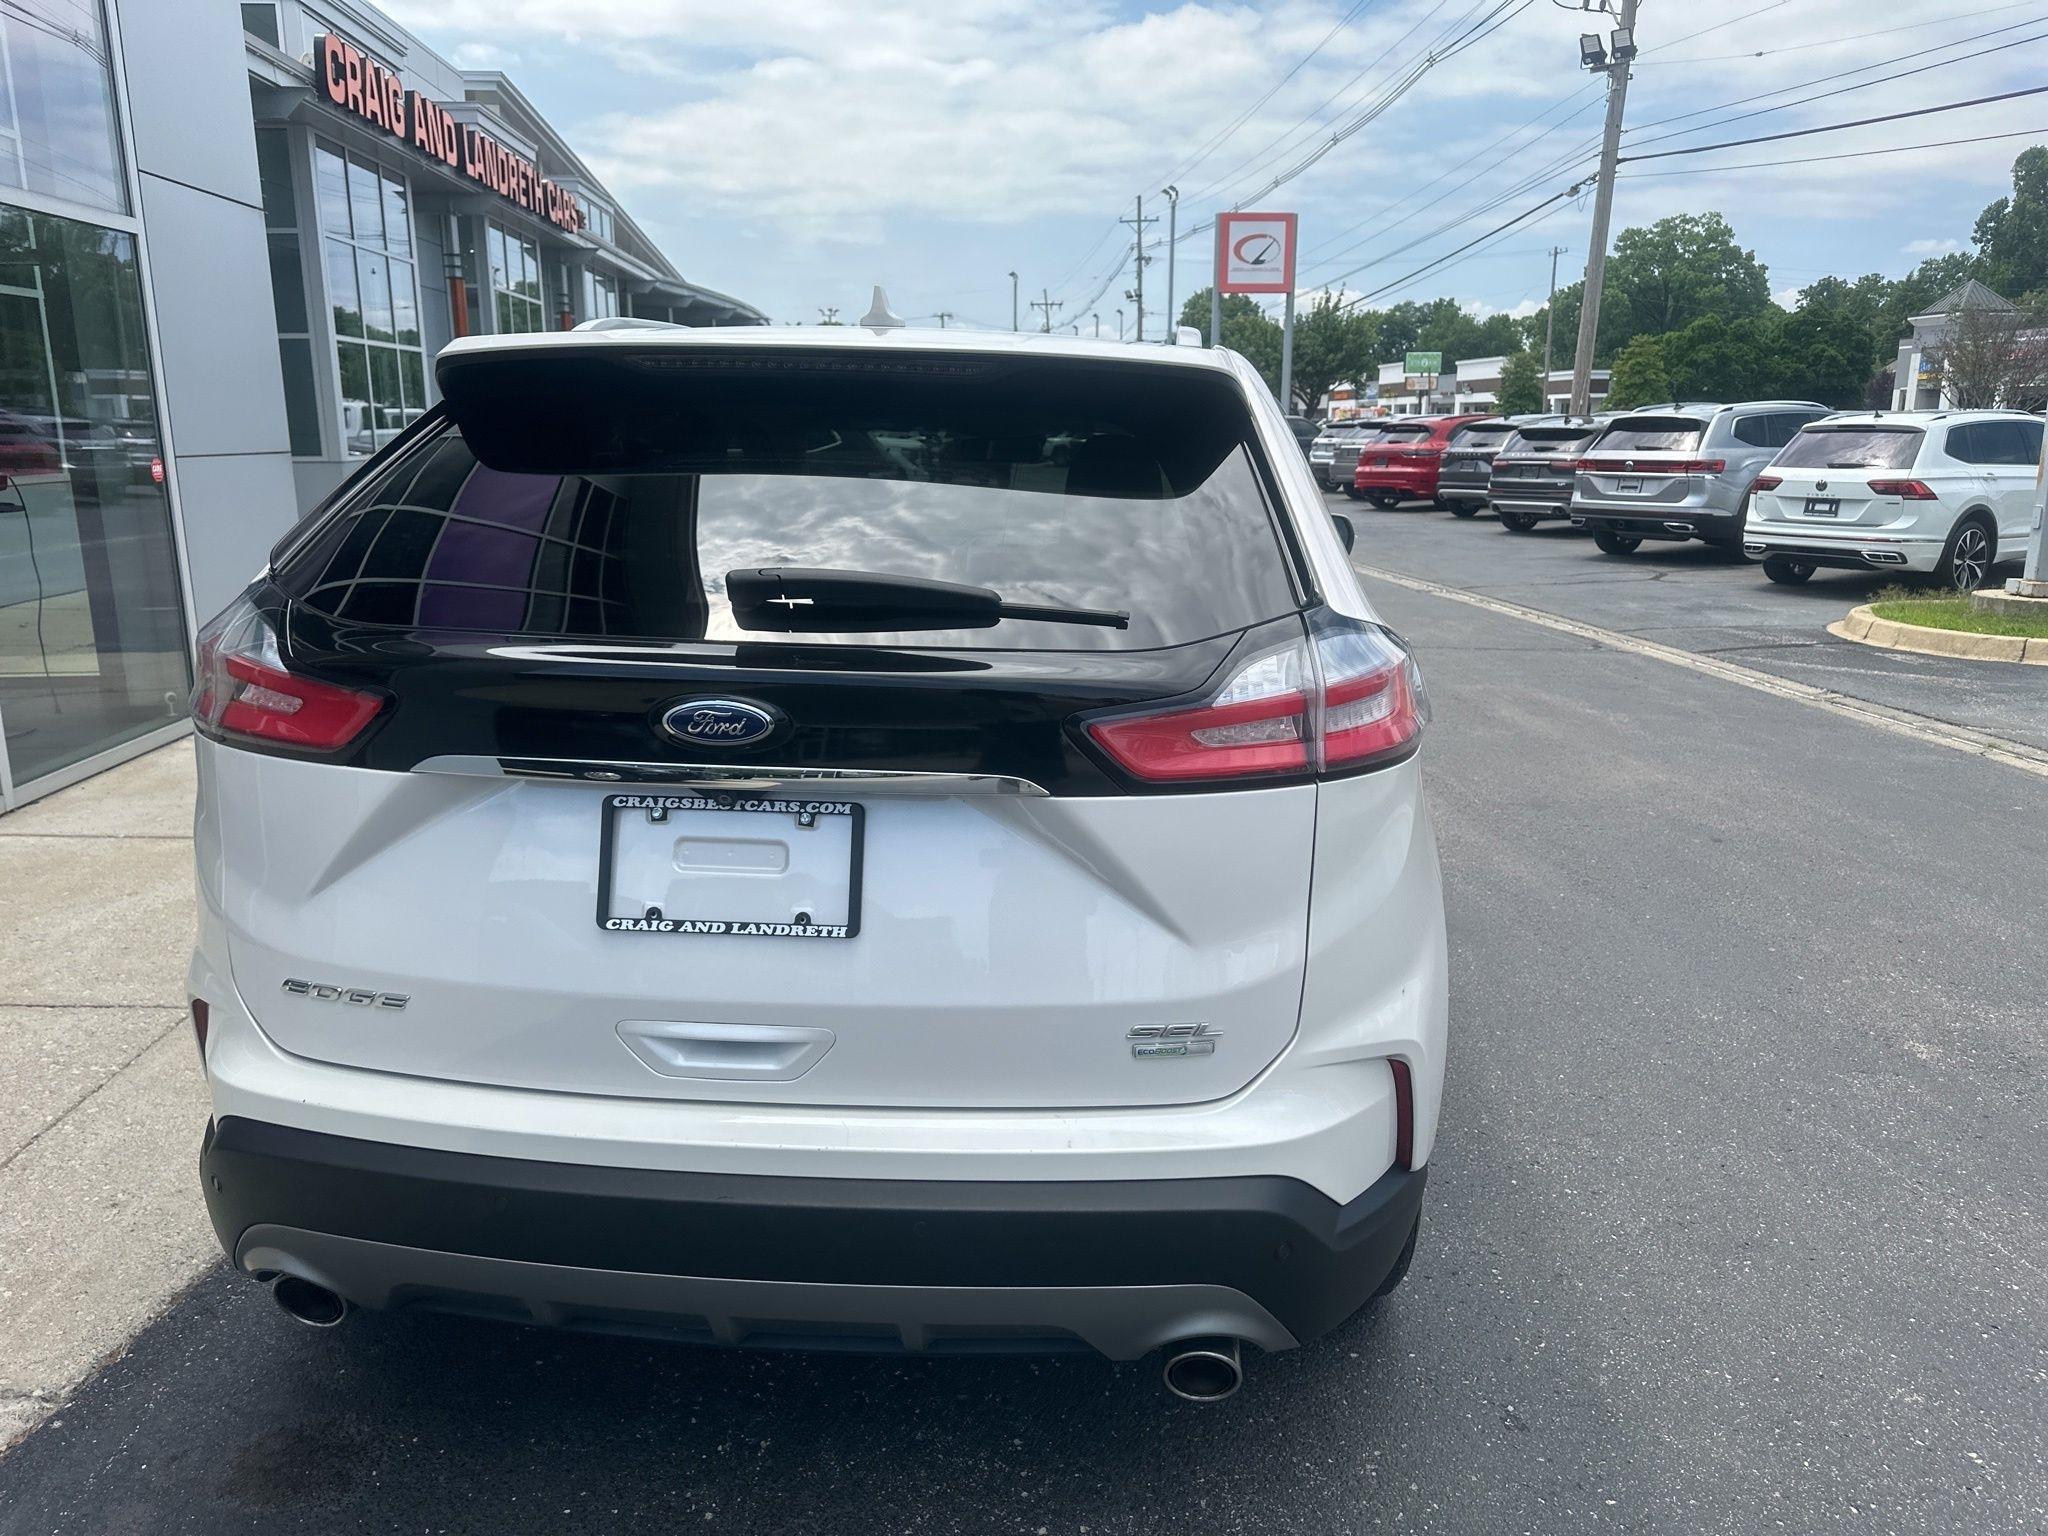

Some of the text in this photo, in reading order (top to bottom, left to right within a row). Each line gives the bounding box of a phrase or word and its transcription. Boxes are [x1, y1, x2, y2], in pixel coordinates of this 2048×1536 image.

[321, 32, 579, 234] CRAIG AND LANDRETH CARS
[687, 709, 747, 735] Ford
[605, 918, 848, 938] CRAIG AND LANDRETH
[282, 977, 411, 1010] EDGE
[1126, 1021, 1224, 1038] SEL
